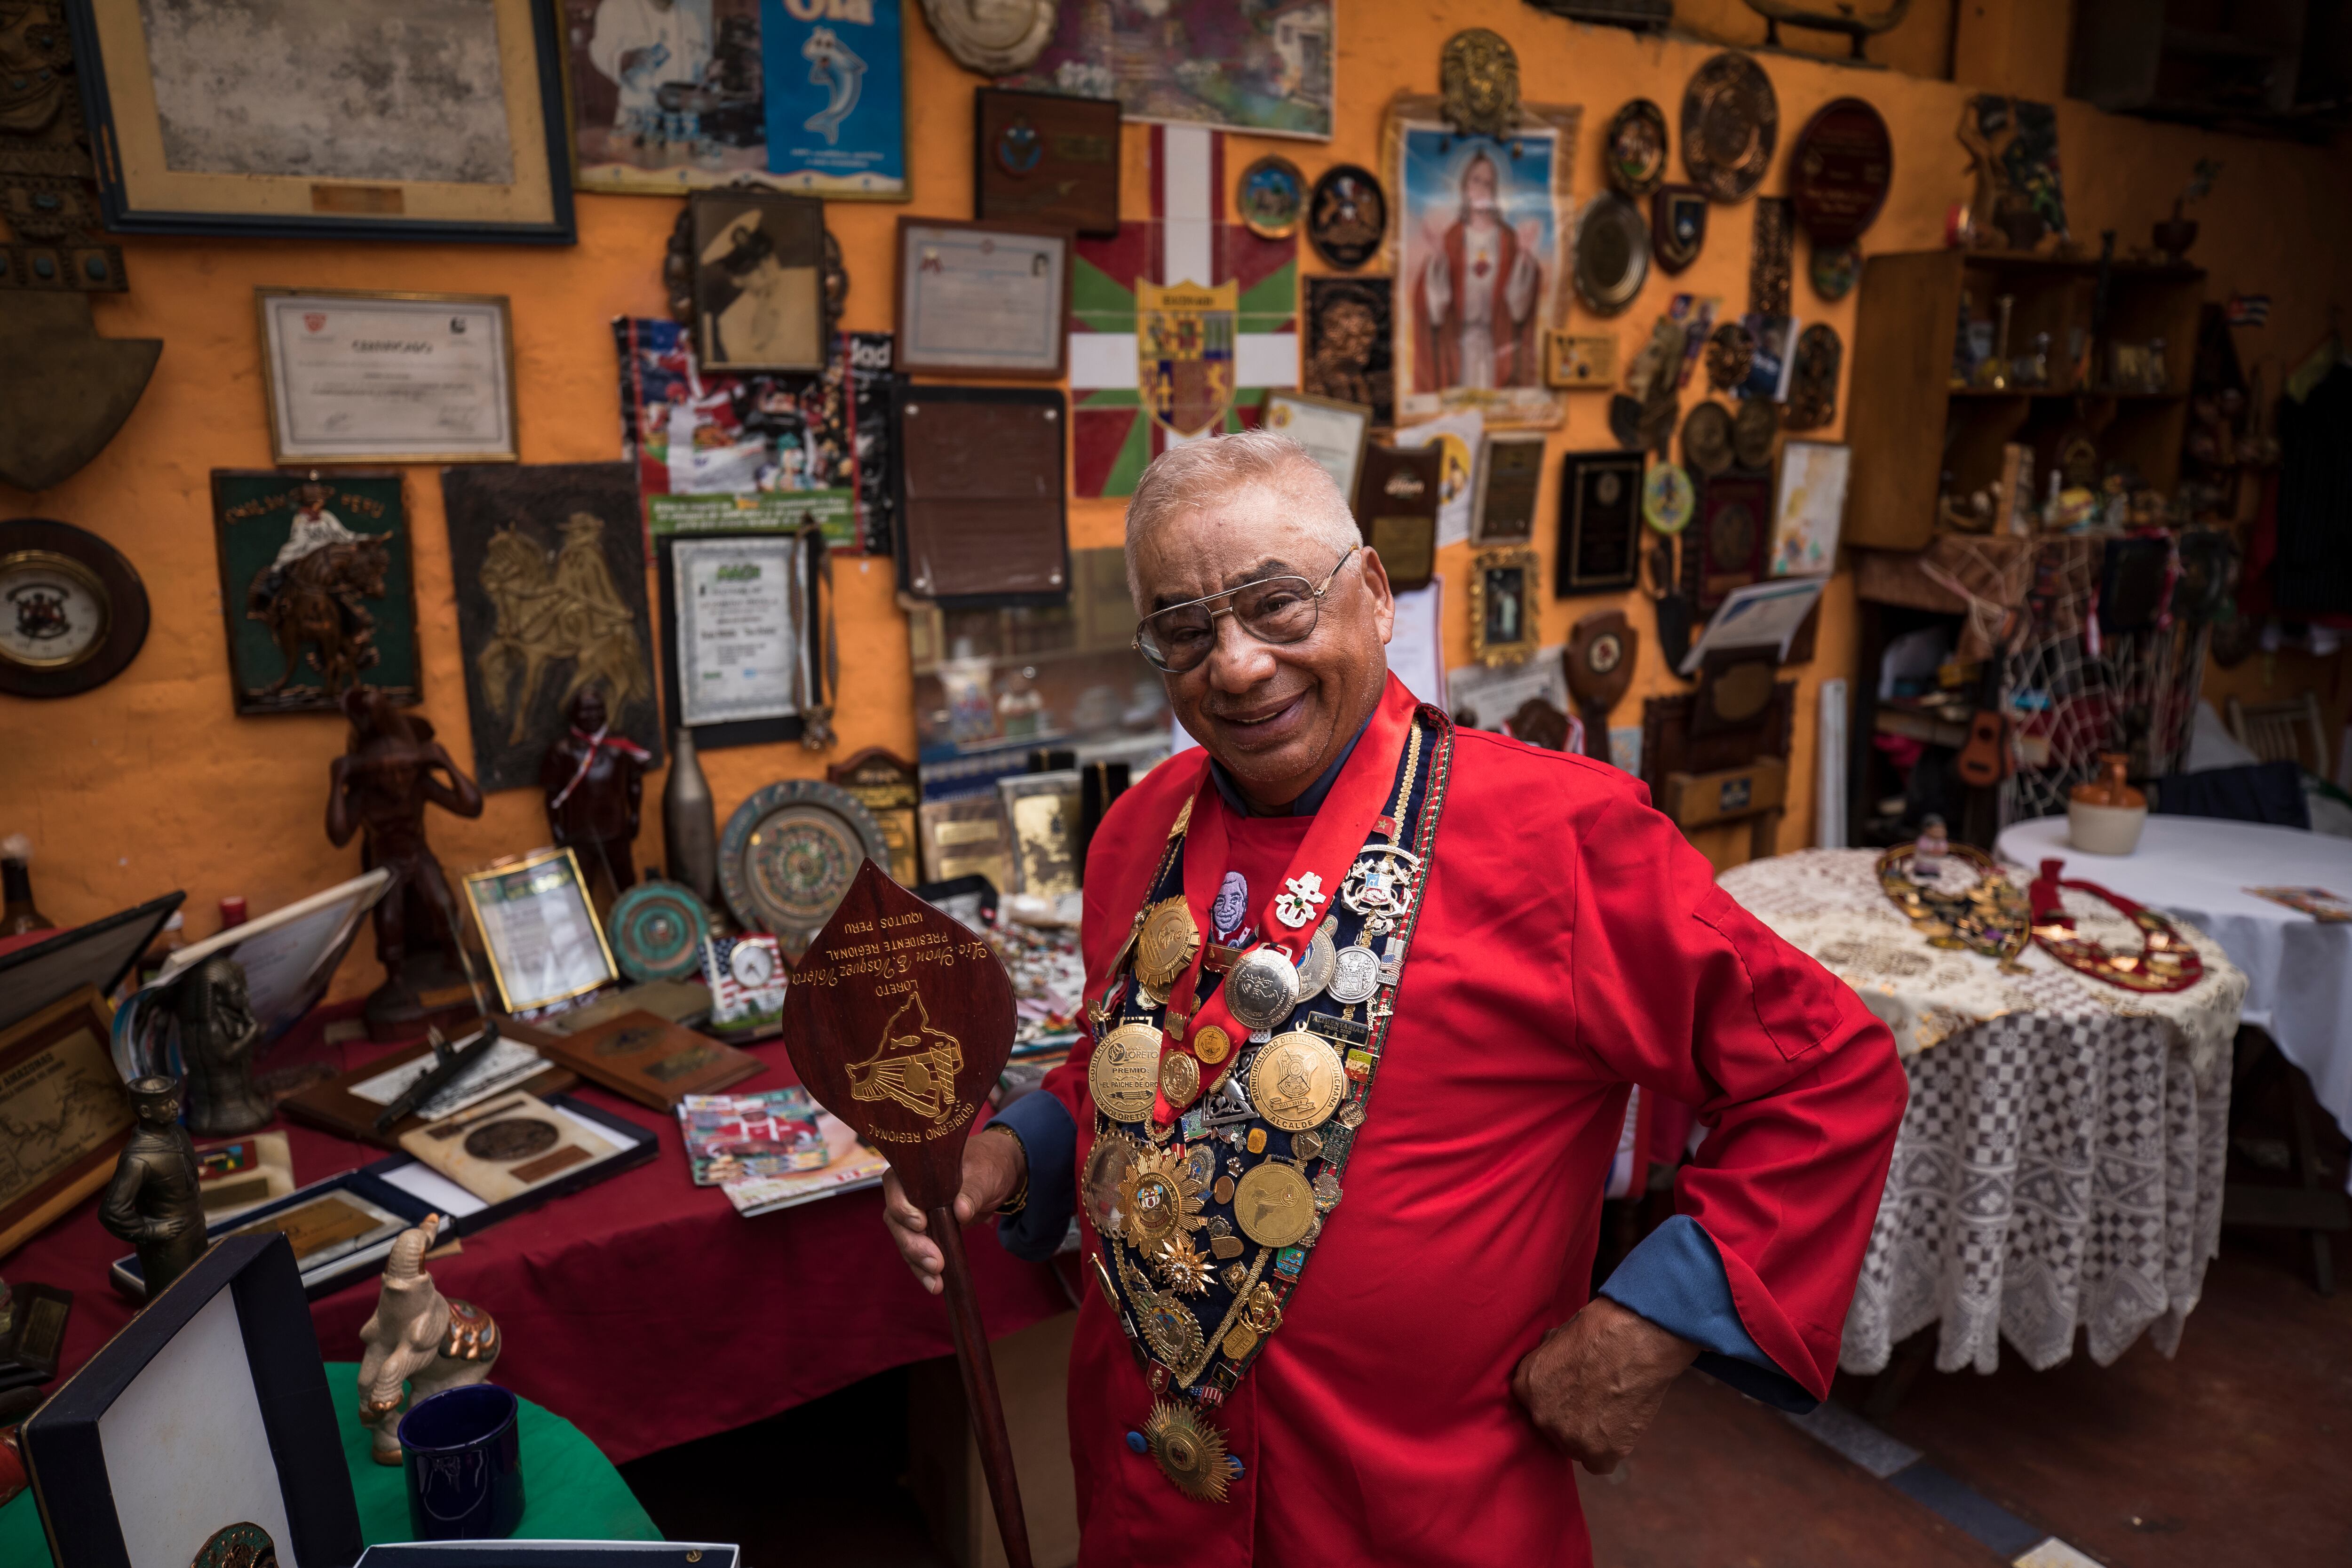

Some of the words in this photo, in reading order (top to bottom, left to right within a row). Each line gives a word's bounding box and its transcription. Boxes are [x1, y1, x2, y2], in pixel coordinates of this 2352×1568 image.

[845, 920, 874, 934] PERU
[880, 912, 923, 929] IQUITOS
[883, 932, 948, 951] PRESIDENTE
[1320, 939, 1331, 961] CERRO
[826, 943, 879, 961] REGIONAL
[839, 957, 894, 979] Vasquez
[1319, 963, 1331, 980] AZUL
[875, 979, 919, 997] LORETO
[1366, 995, 1377, 1031] Grandma
[1196, 1027, 1223, 1040] PROMOCION
[1312, 1015, 1365, 1034] ALIMENTARIAS
[1090, 1037, 1111, 1082] GOBIERNO
[1112, 1027, 1153, 1039] REGIONAL
[1125, 1051, 1159, 1059] LORETO
[2, 1052, 54, 1085] AMAZONAS
[1251, 1041, 1278, 1101] MUNICIPALIDAD
[1280, 1035, 1320, 1050] DISTRITAL
[1322, 1048, 1332, 1060] DE
[1327, 1061, 1340, 1108] PUNCHANA
[1367, 1058, 1377, 1082] MEXICO
[1097, 1096, 1146, 1121] EXPOLORETO
[925, 1103, 975, 1140] GOBIERNO
[1270, 1116, 1314, 1129] ALCALDE
[868, 1123, 922, 1143] REGIONAL
[1239, 1171, 1255, 1194] ENCUENTRO
[1255, 1165, 1288, 1175] INTERNACIONAL
[1294, 1173, 1310, 1194] ESCUELAS
[1141, 1219, 1156, 1228] HUESPED
[1238, 1215, 1256, 1237] CONGRESO
[1255, 1234, 1279, 1245] NACIONAL
[1287, 1223, 1308, 1243] COCINEROS
